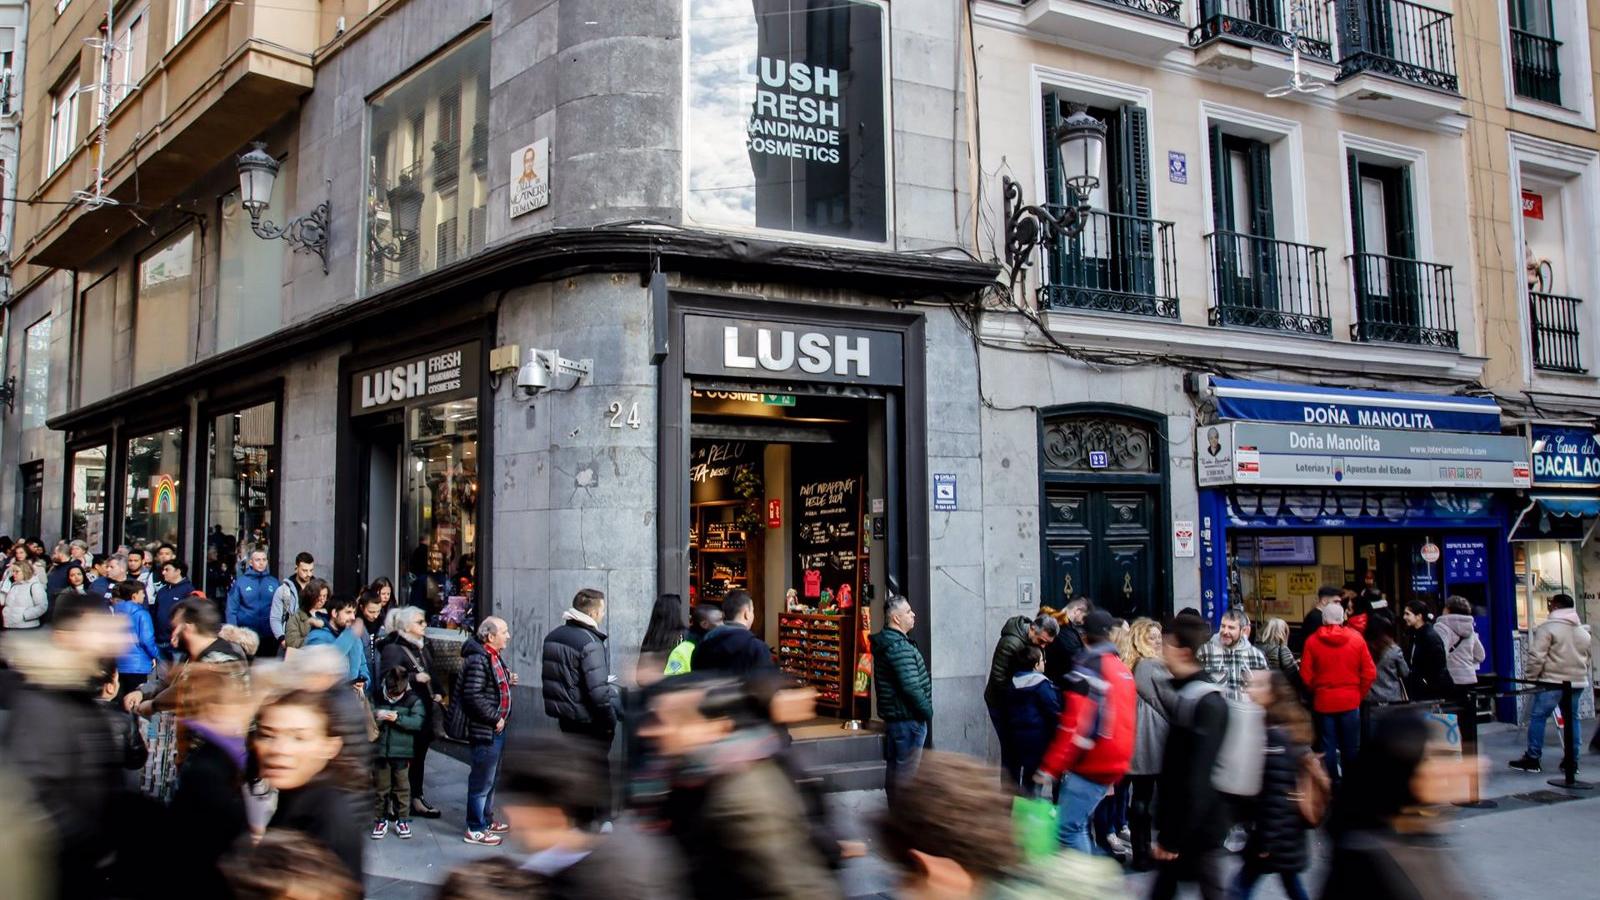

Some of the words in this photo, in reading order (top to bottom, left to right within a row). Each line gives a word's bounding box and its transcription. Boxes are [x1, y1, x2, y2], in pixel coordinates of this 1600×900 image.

[724, 326, 871, 377] LUSH
[361, 360, 426, 408] LUSH
[428, 350, 462, 374] FRESH
[428, 379, 461, 395] COSMETICS
[609, 401, 641, 429] 24
[1303, 405, 1350, 425] DOÑA
[1357, 409, 1434, 429] MANOLITA
[1289, 431, 1324, 449] Doña
[1326, 432, 1381, 451] Manolita
[1555, 435, 1578, 453] Casa
[1581, 438, 1595, 455] del
[1092, 455, 1104, 465] 22
[1346, 464, 1377, 475] Apuestas
[1378, 464, 1389, 474] del
[1390, 465, 1412, 475] Estado
[1534, 455, 1600, 477] BACALAO
